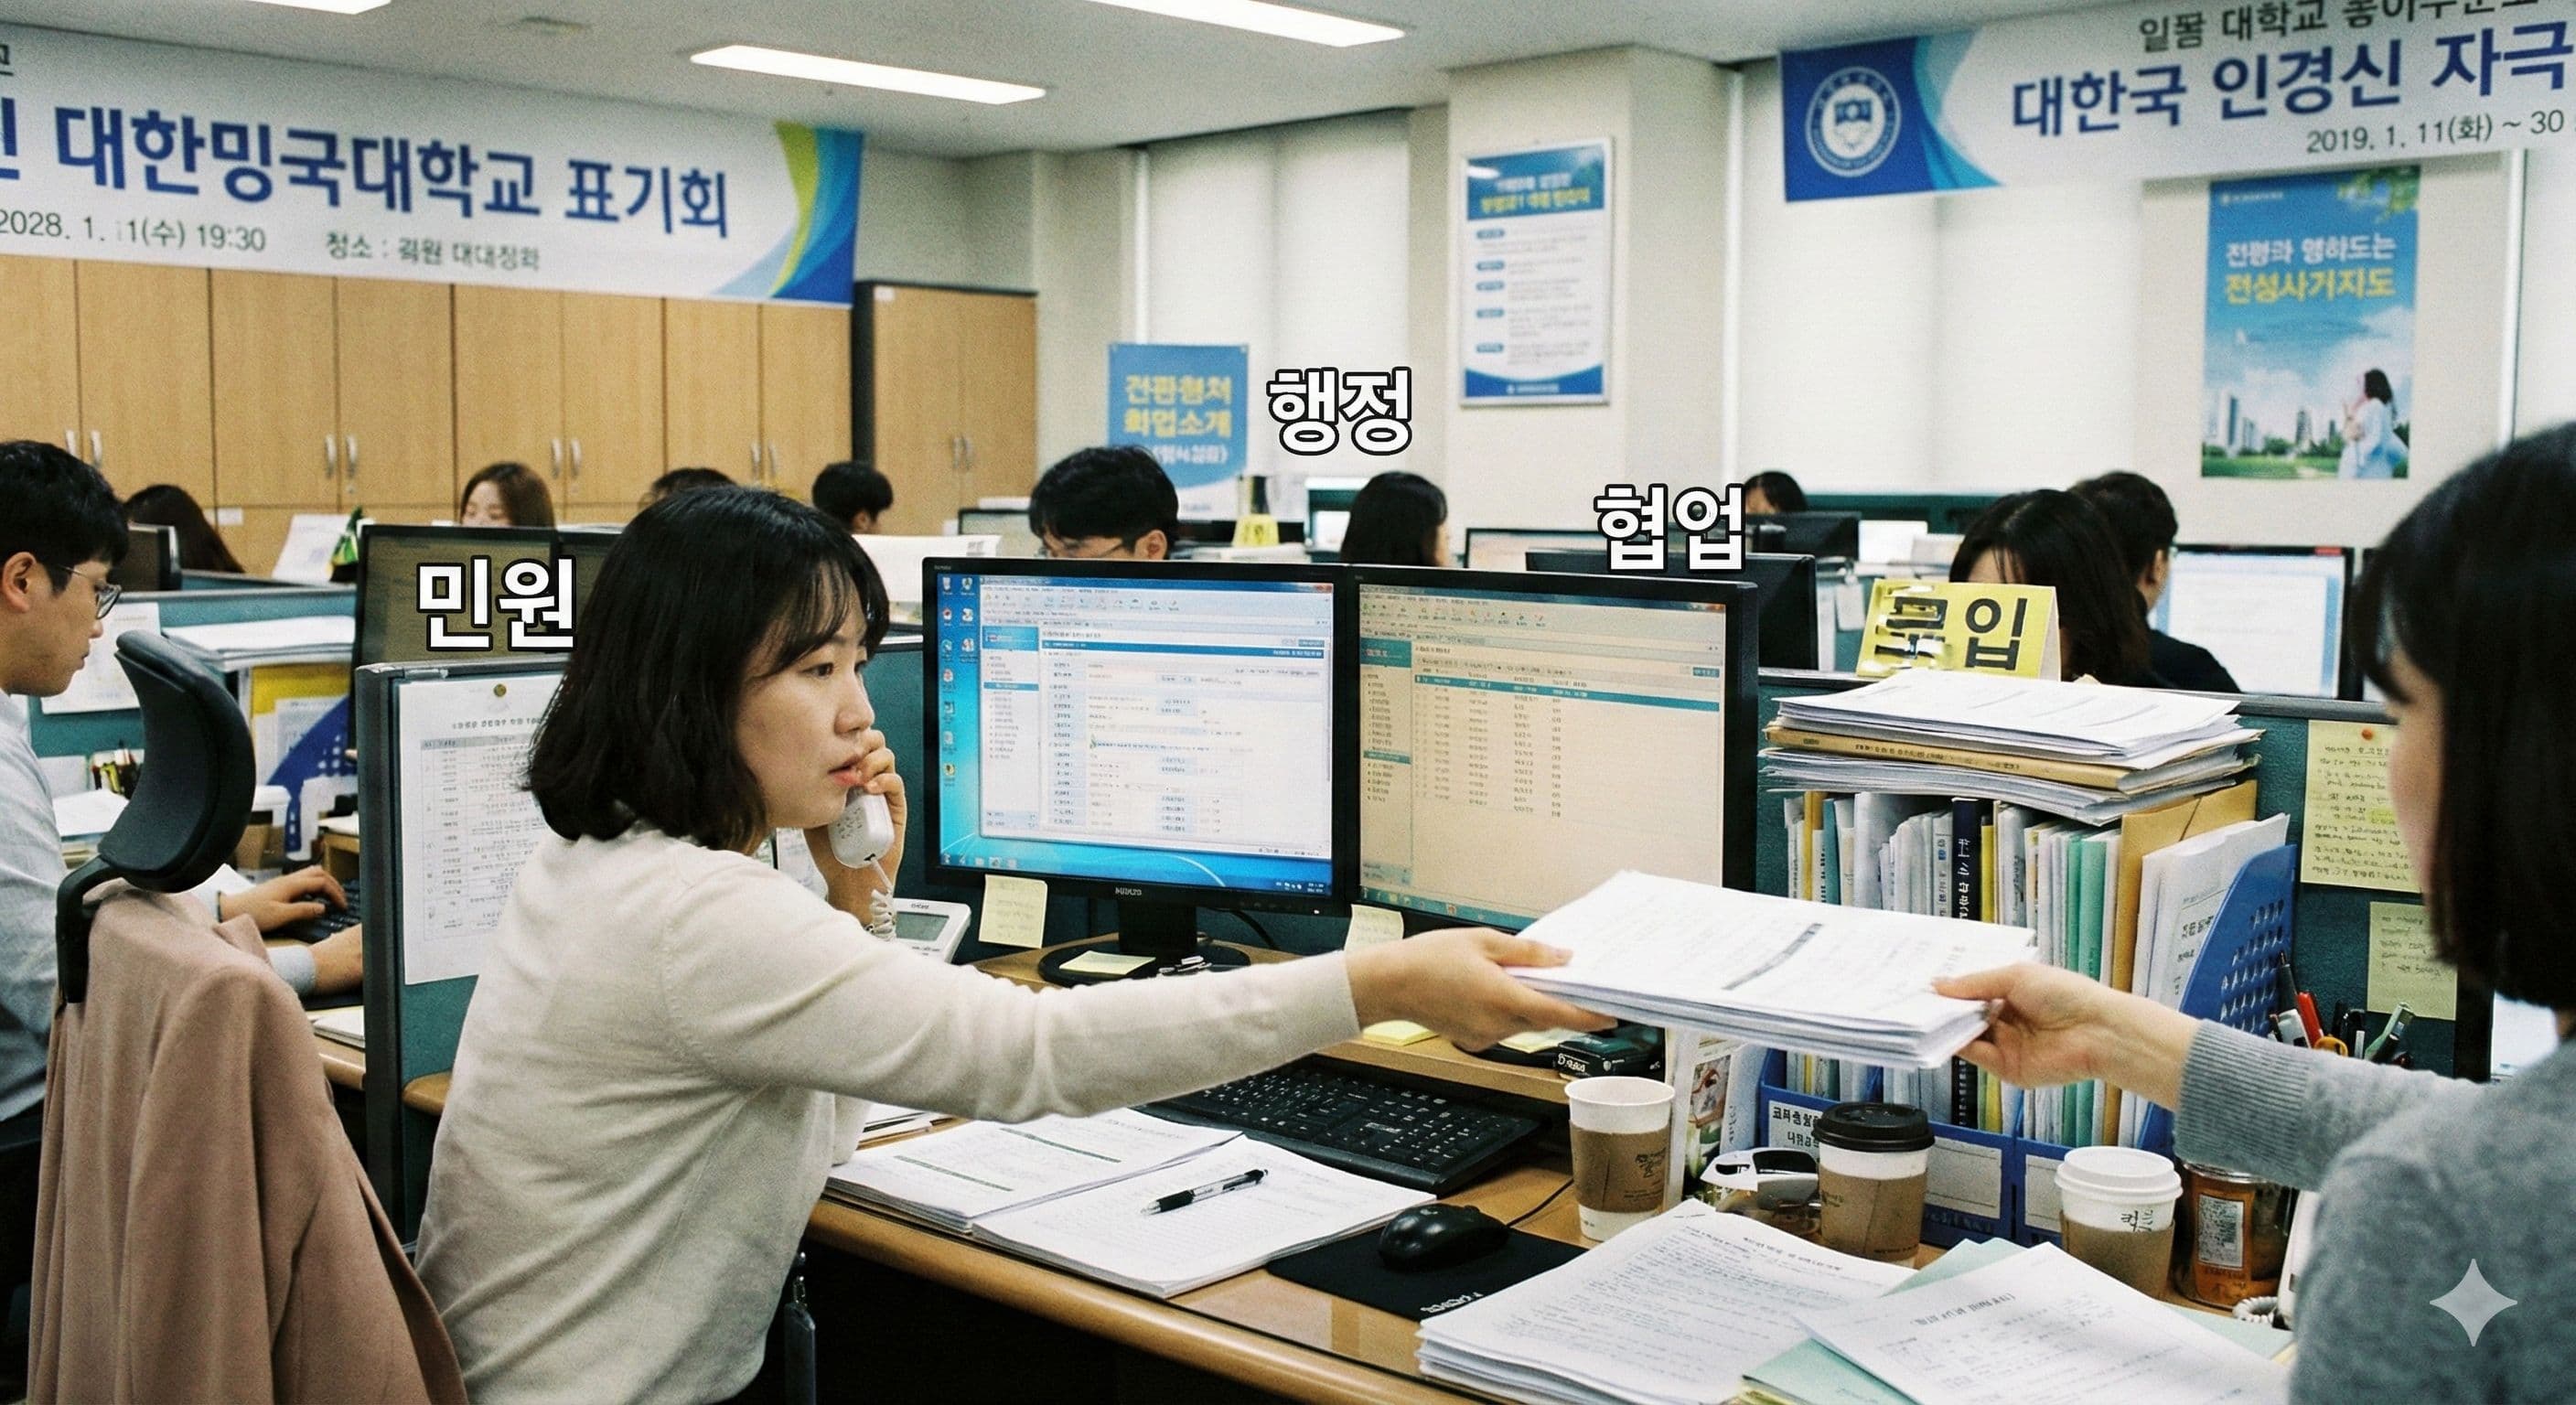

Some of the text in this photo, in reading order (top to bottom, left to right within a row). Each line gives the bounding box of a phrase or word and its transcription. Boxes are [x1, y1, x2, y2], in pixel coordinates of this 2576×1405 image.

[2222, 0, 2328, 40] 대학교
[2013, 21, 2574, 137] 대한국 인경신 자극
[2306, 126, 2375, 154] 2019.
[2387, 125, 2406, 149] 1.
[2418, 113, 2493, 144] 11(화)
[55, 106, 541, 219] 대한밍국대학교
[564, 159, 730, 238] 표기회
[197, 223, 266, 252] 19:30
